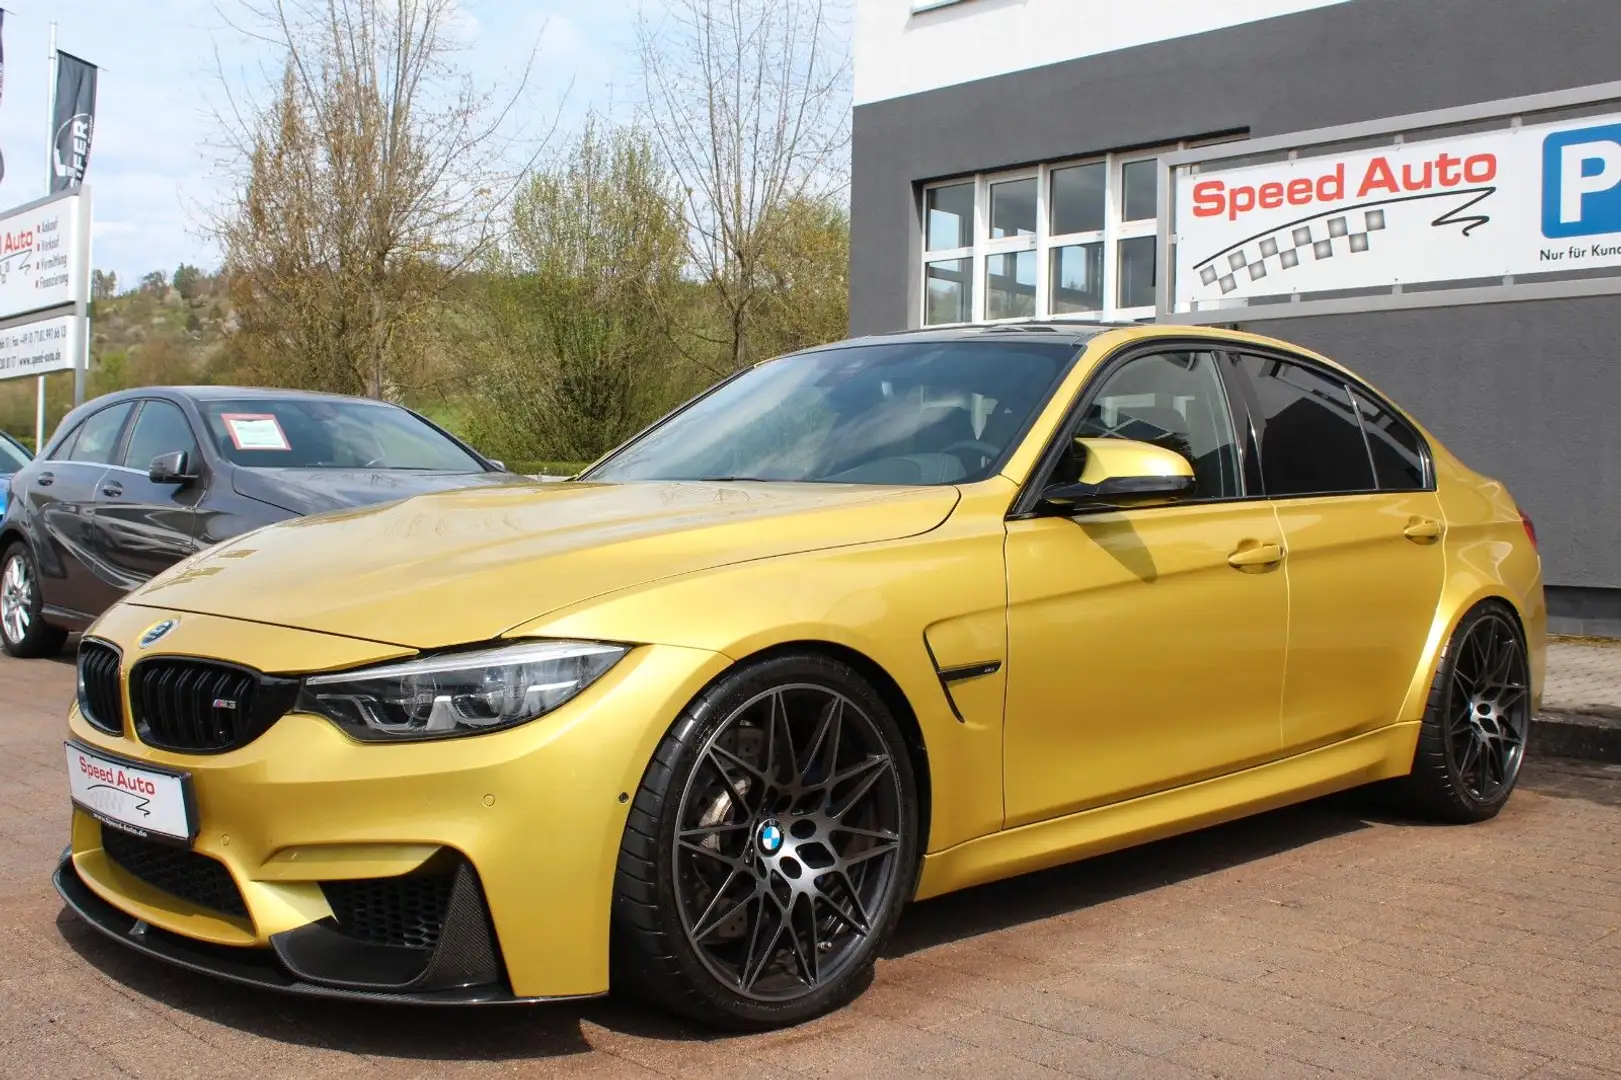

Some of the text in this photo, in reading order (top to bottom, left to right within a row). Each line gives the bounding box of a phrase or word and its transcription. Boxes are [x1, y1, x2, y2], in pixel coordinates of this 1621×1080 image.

[1192, 153, 1498, 221] Speed Auto
[1559, 140, 1621, 224] P
[4, 230, 33, 254] Auto
[1540, 249, 1564, 261] Nur
[1568, 245, 1586, 258] für
[80, 756, 155, 795] Speed Auto
